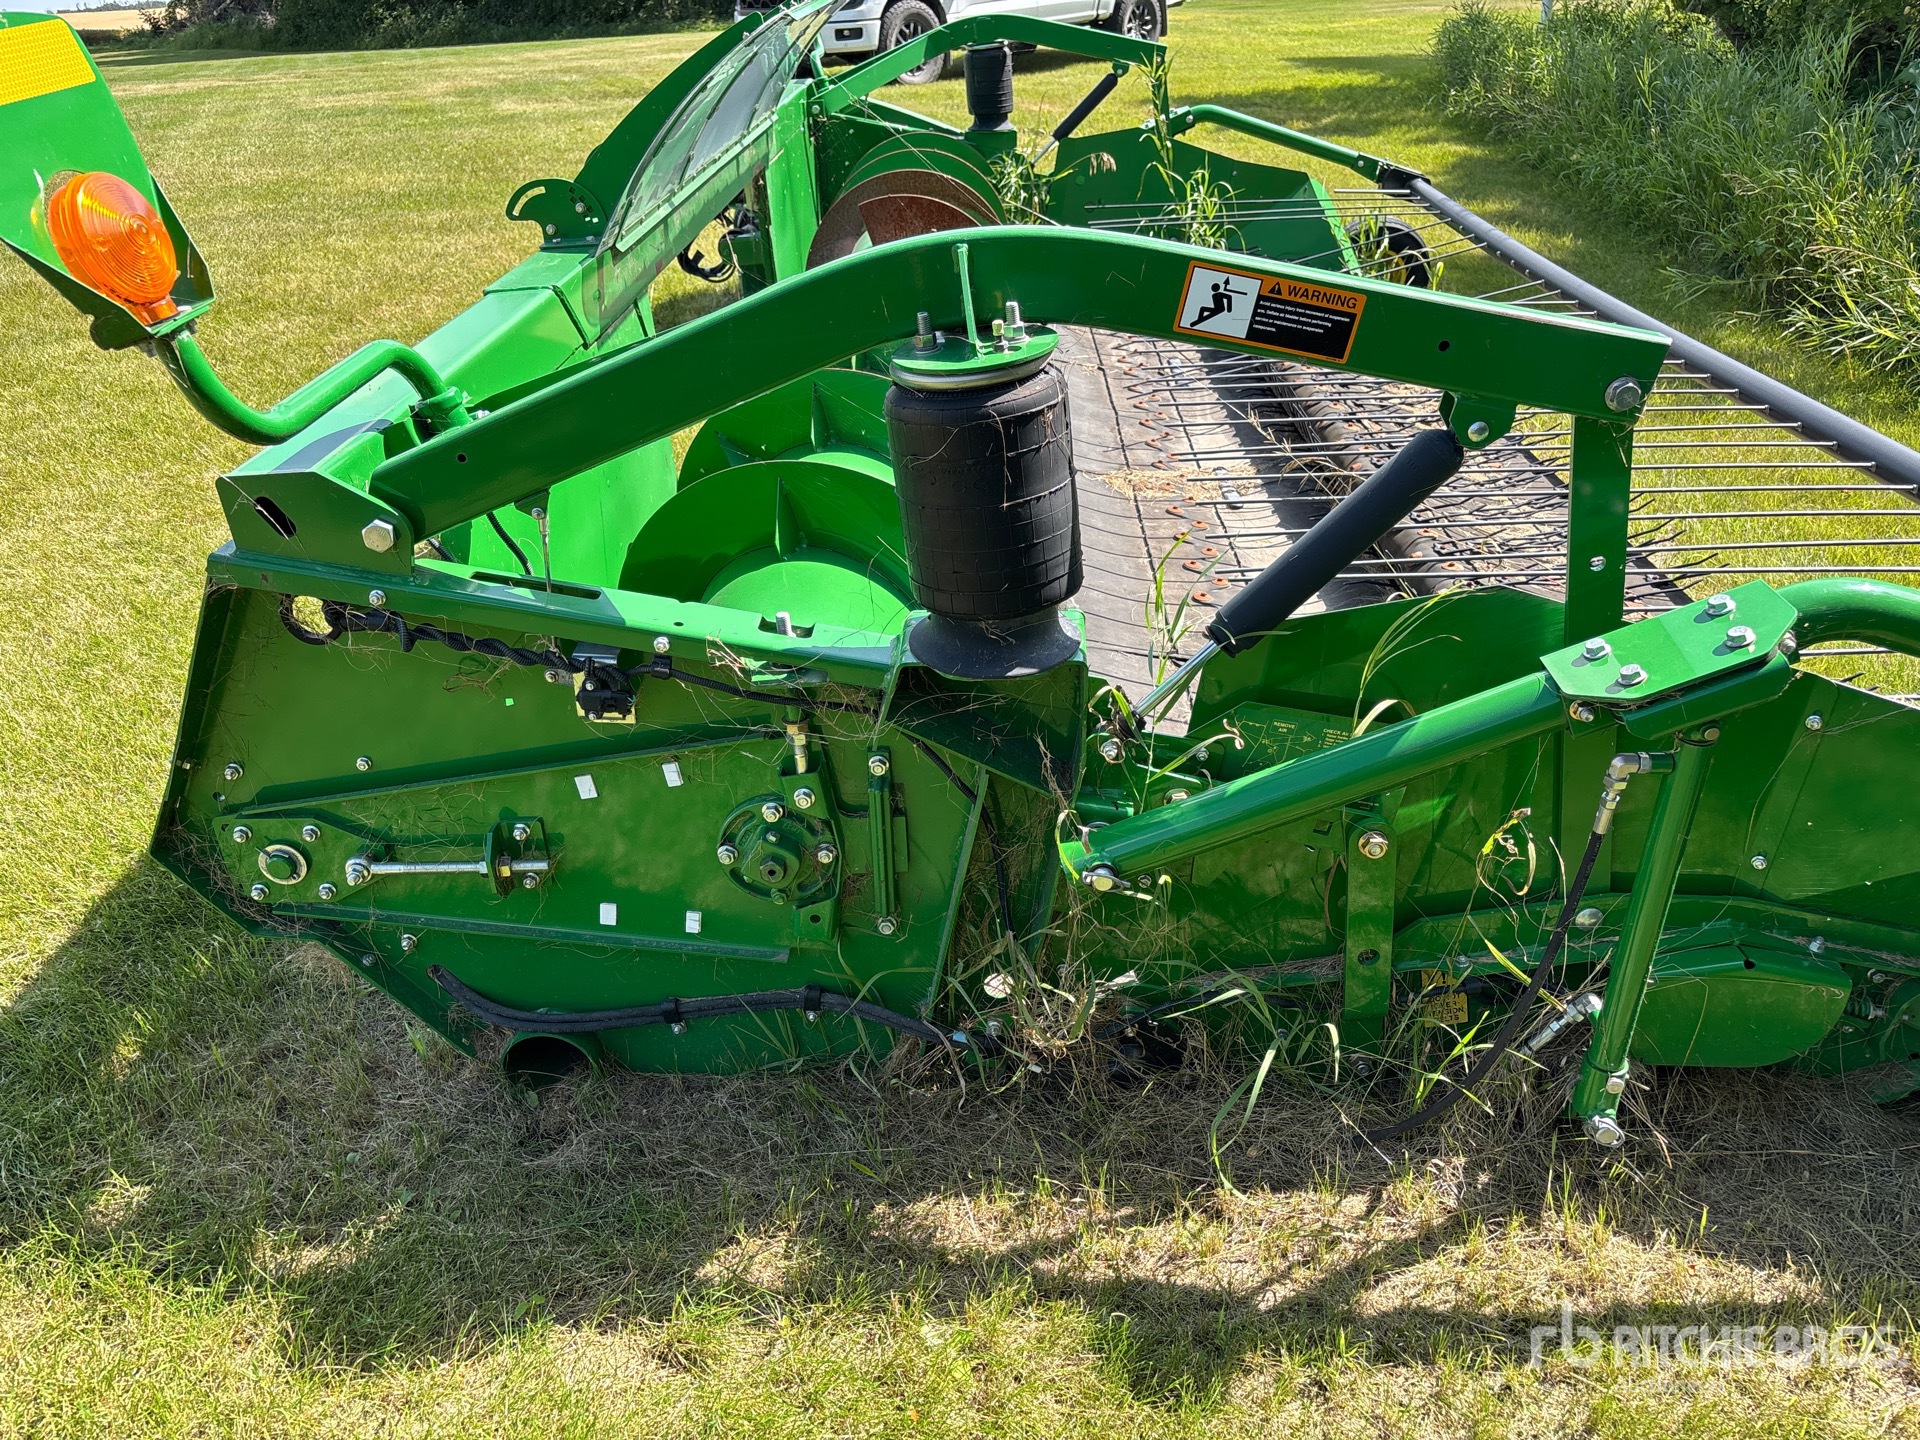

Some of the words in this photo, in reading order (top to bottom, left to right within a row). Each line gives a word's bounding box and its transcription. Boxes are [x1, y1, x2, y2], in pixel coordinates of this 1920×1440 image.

[1288, 284, 1358, 310] WARNING
[1311, 319, 1332, 328] performing
[1302, 325, 1324, 333] suspension
[1273, 721, 1296, 730] REMOVE
